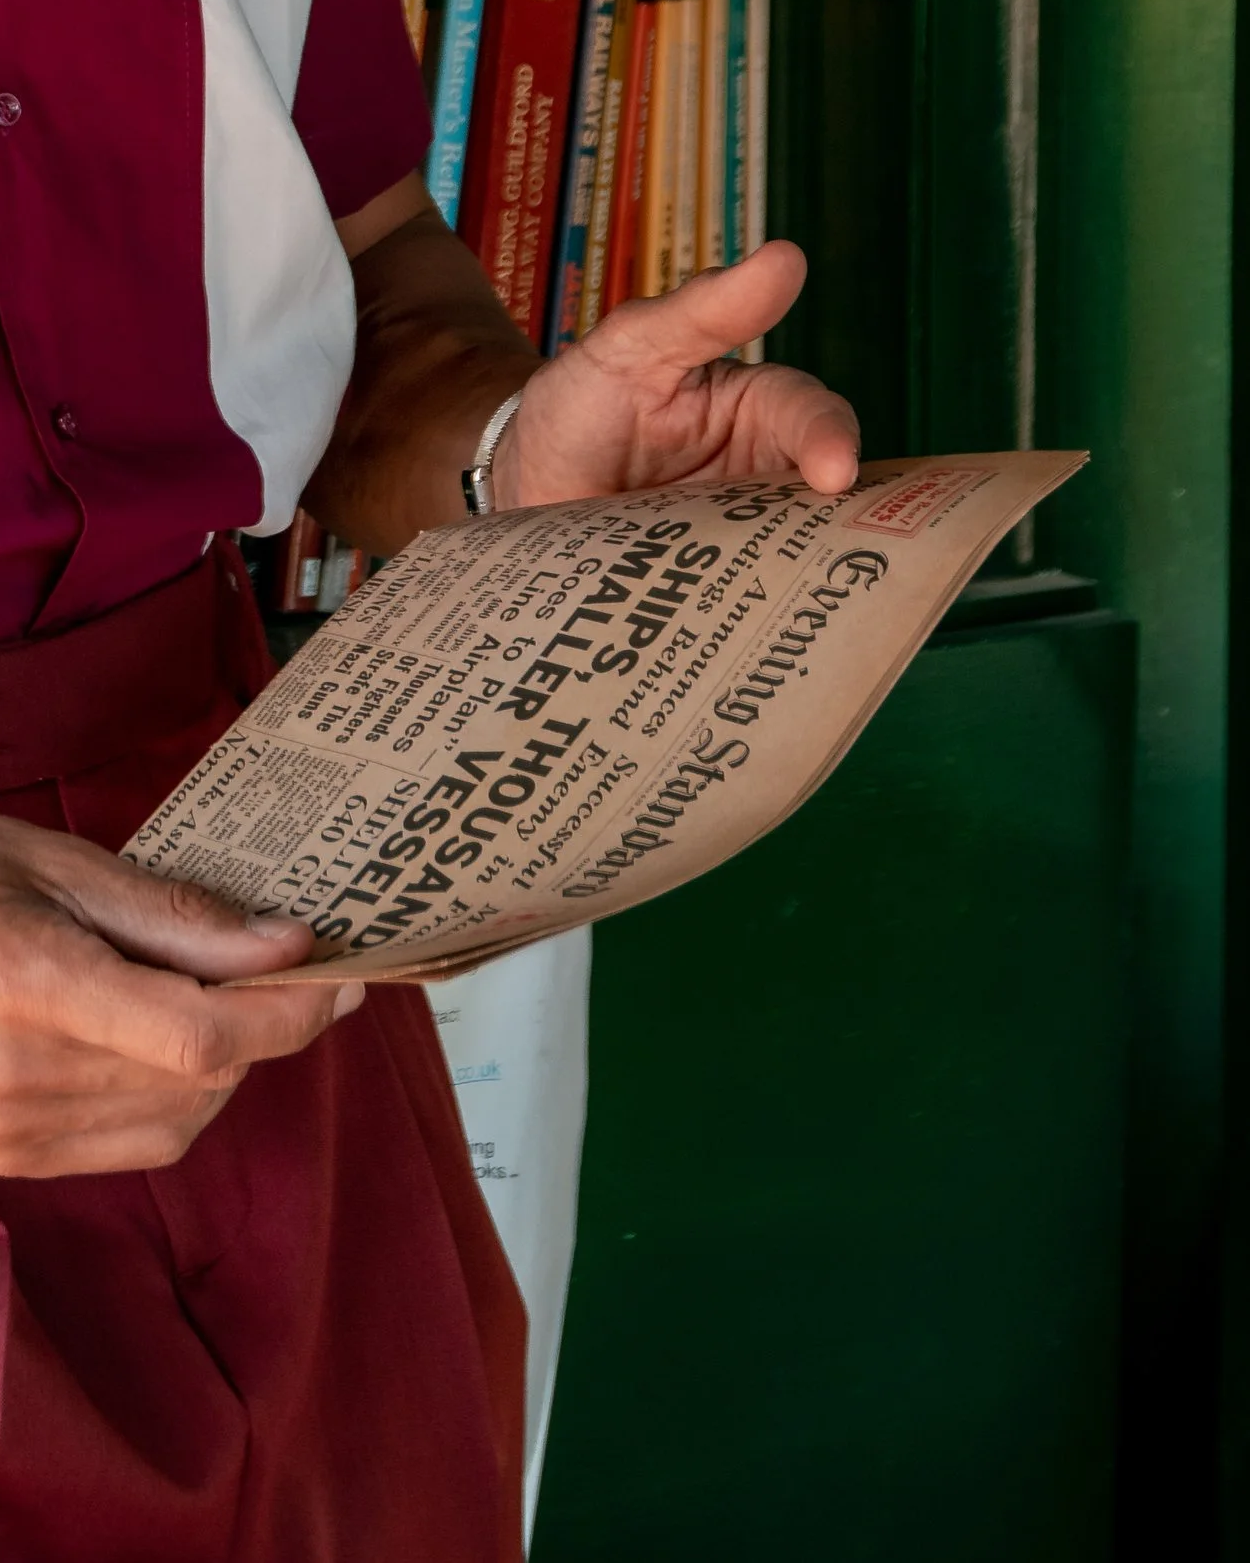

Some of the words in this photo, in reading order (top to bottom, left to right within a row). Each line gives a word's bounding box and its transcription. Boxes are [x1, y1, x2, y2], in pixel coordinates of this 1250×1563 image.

[443, 19, 478, 134] Master's
[579, 12, 612, 149] RAILWAYS
[499, 63, 536, 202] GUILDFORD
[523, 93, 556, 207] COMPANY
[596, 78, 623, 185] RAILWAYS
[589, 187, 610, 241] THEN
[511, 209, 543, 319] RAILWAY
[584, 244, 604, 288] AND
[579, 289, 598, 329] NO
[709, 482, 770, 507] OF
[778, 474, 903, 559] Churchill
[876, 481, 939, 523] BIRD'S
[503, 521, 554, 559] Churchill
[522, 524, 563, 554] smaller
[528, 542, 555, 564] more
[554, 516, 622, 558] First
[556, 527, 571, 537] of
[603, 519, 642, 544] All
[378, 553, 407, 573] ON
[449, 560, 466, 572] HE
[464, 564, 505, 595] to-day,
[490, 558, 522, 584] craft,
[500, 567, 529, 591] than
[696, 497, 813, 615] Landings
[392, 606, 407, 618] AS
[470, 591, 496, 607] has
[477, 596, 502, 619] 4000
[499, 572, 560, 624] Line
[534, 558, 602, 621] Goes
[573, 542, 718, 681] SHIPS,
[362, 595, 409, 639] EUROPEAN
[370, 626, 392, 641] THE
[421, 600, 466, 650] announc-
[433, 612, 470, 650] crossed
[446, 623, 479, 653] ships,
[494, 519, 691, 720] SMALLER
[714, 551, 884, 718] Evening
[333, 641, 373, 678] Nazi
[345, 650, 393, 694] Strafe
[392, 656, 418, 674] Of
[502, 637, 535, 664] to
[640, 575, 766, 737] Announces
[296, 680, 337, 719] Guns
[393, 633, 501, 756] Airplanes
[608, 623, 700, 731] Behind
[316, 705, 351, 731] The
[334, 679, 399, 746] Fighters
[364, 662, 443, 741] Thousands
[137, 727, 248, 845] Normandy
[518, 739, 610, 842] Enemy
[321, 796, 368, 844] 640
[512, 753, 638, 891] Successful
[562, 727, 746, 898] Standard
[144, 808, 193, 868] Asho
[289, 778, 418, 917] SHELLED
[309, 751, 505, 941] VESSELS
[323, 719, 590, 963] THOUSAND
[254, 856, 319, 915] GUN
[477, 852, 513, 885] in
